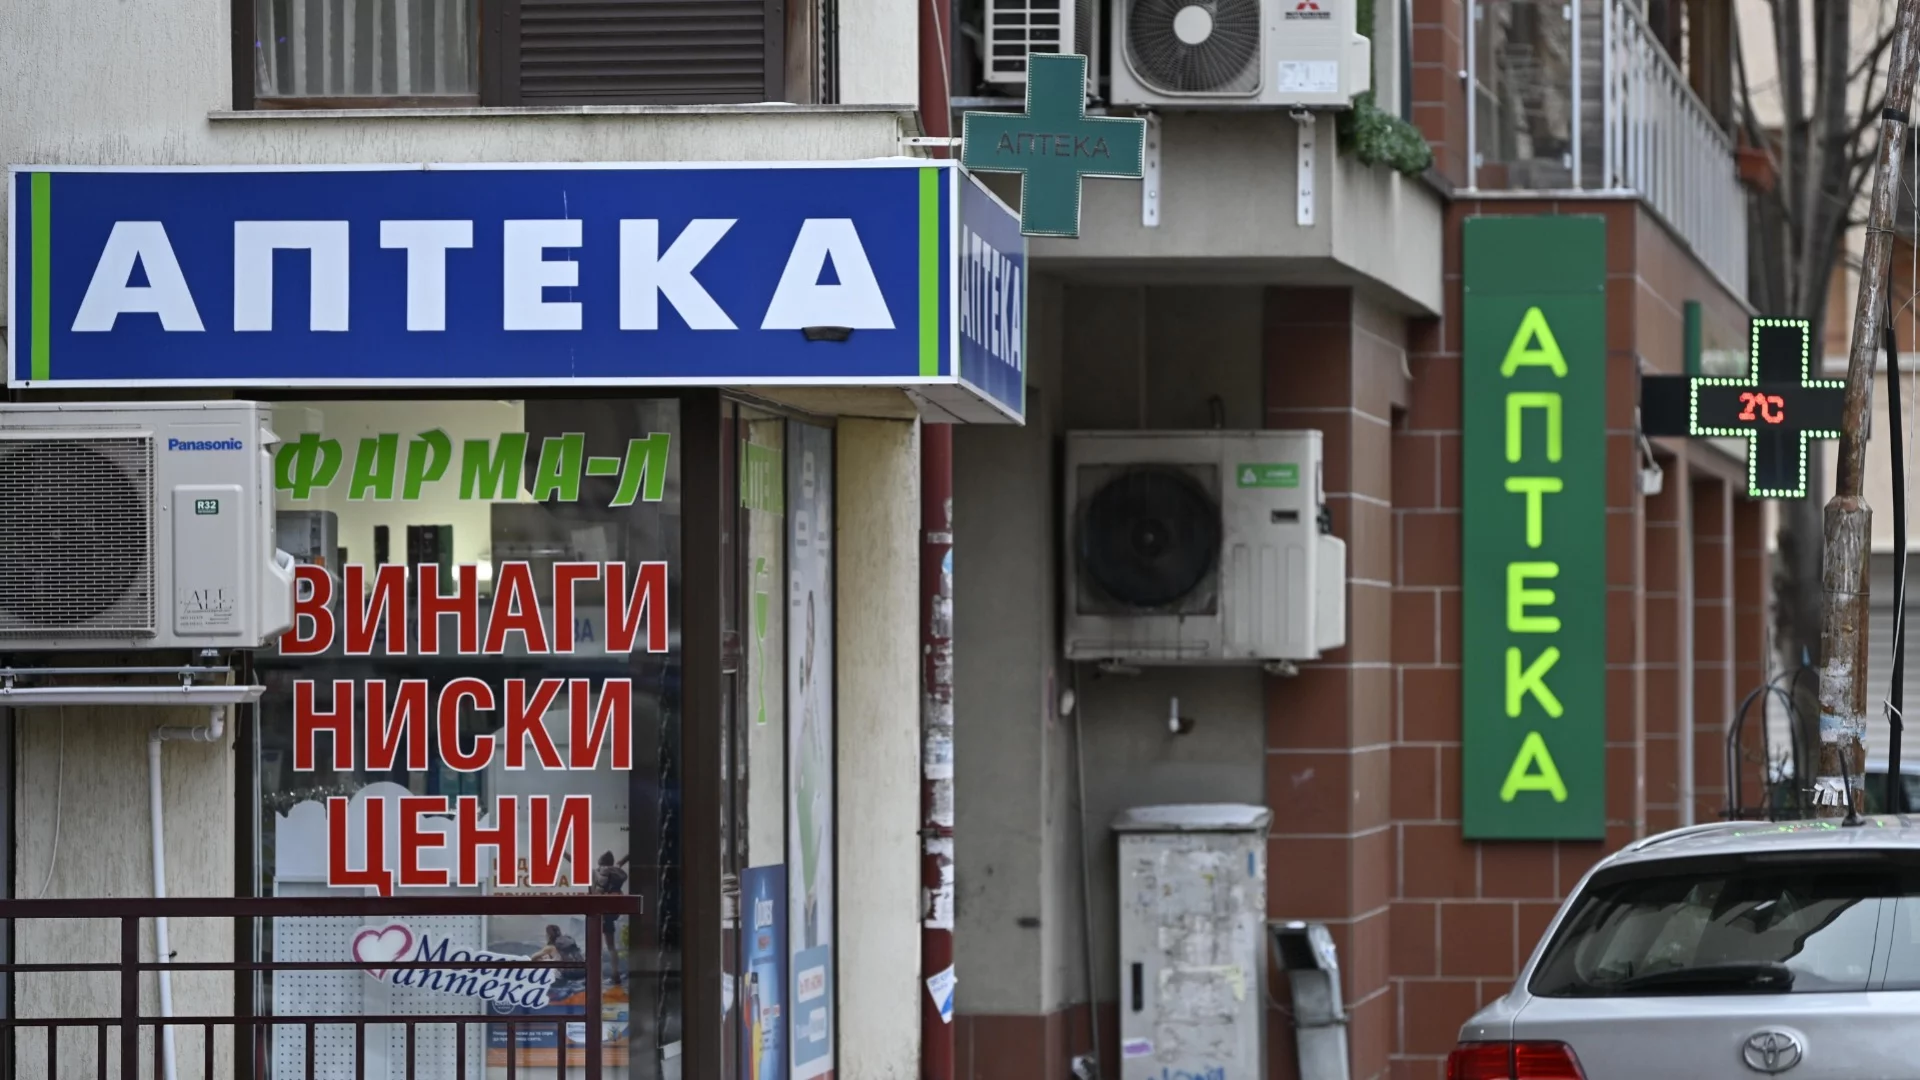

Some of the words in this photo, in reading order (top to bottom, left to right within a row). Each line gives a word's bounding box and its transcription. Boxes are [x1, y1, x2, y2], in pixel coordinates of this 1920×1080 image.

[996, 130, 1112, 159] АПТЕКА
[70, 217, 897, 333] АПТЕКА
[960, 223, 1022, 372] АПТЕКА
[168, 437, 243, 451] Panasonic
[275, 427, 670, 508] ФАРМА-Л
[197, 501, 217, 509] R32
[1500, 306, 1568, 803] АПТЕКА
[279, 561, 669, 656] ВИНАГИ
[292, 677, 633, 772] НИСКИ
[327, 794, 592, 897] ЦЕНИ
[392, 967, 549, 1007] аптека
[413, 934, 551, 985] Моята
